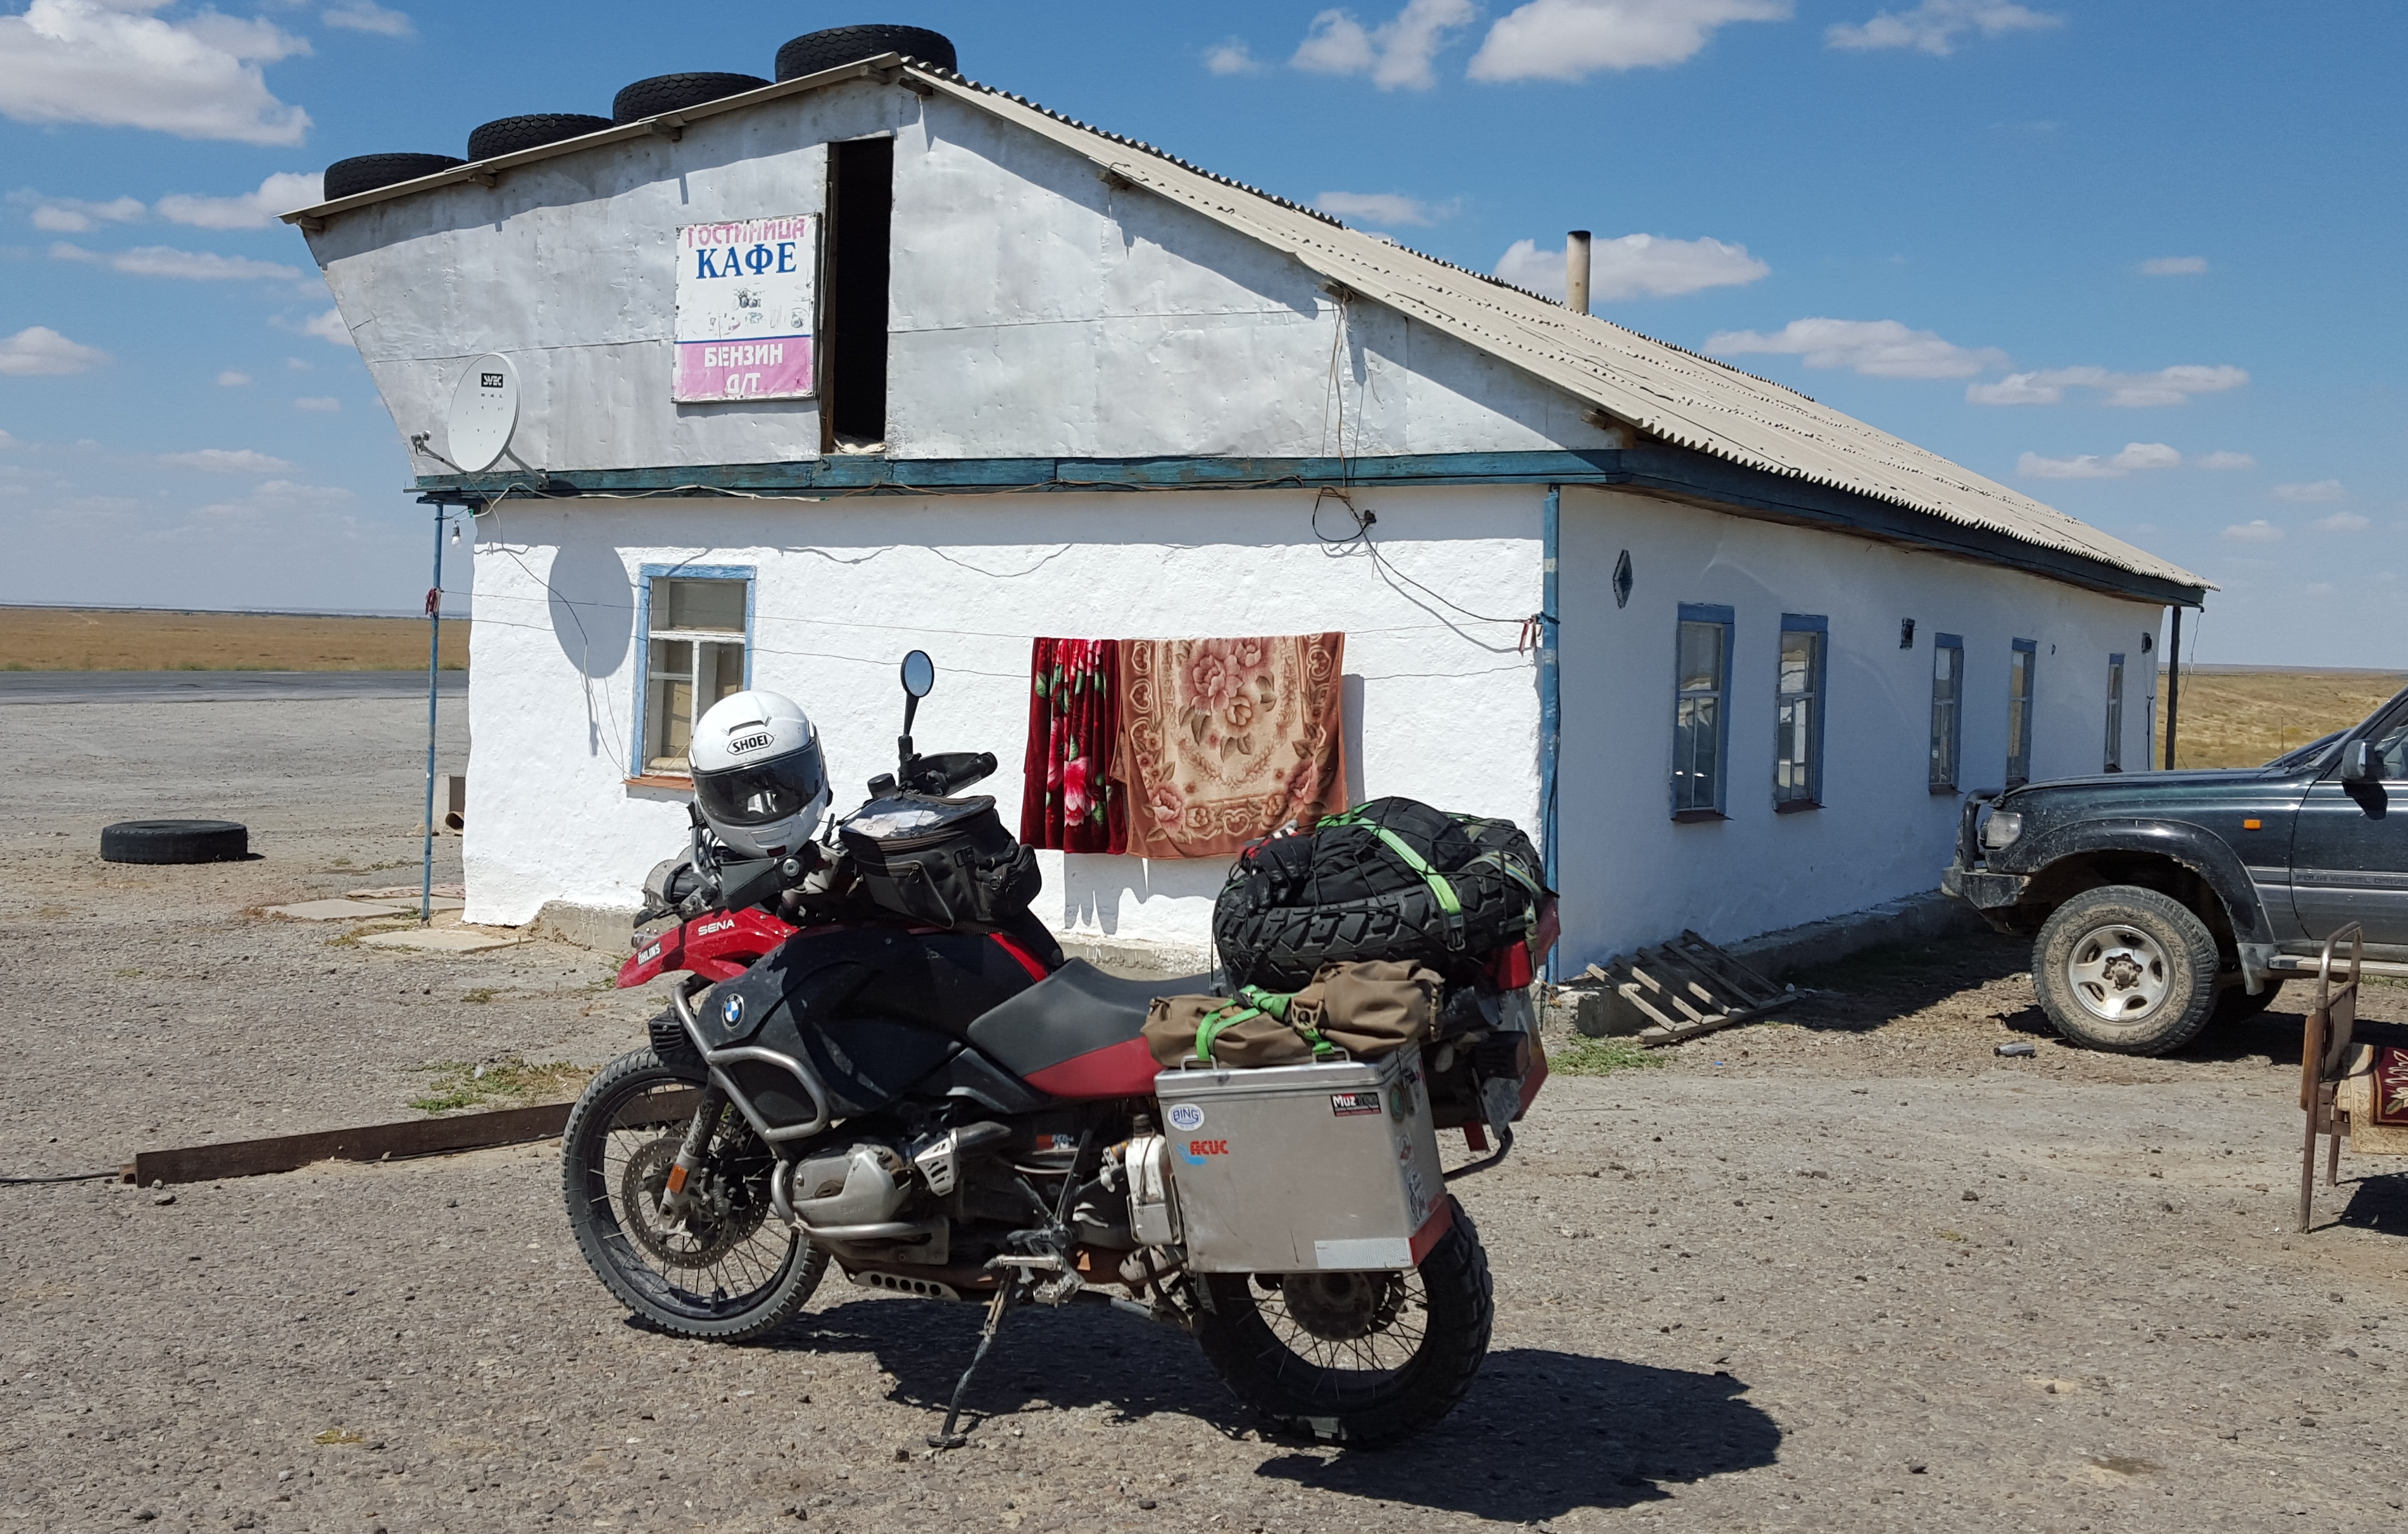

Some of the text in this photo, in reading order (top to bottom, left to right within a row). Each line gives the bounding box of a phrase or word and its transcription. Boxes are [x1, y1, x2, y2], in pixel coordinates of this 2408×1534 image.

[687, 218, 806, 249] ГОСТИНИЦА
[696, 242, 797, 279] КАФЕ
[704, 343, 784, 369] БЕНЗИН
[726, 373, 761, 394] Д/Т
[732, 734, 768, 753] SHOEI
[2330, 876, 2371, 884] WHEEL
[698, 919, 735, 936] SENA
[1173, 1108, 1199, 1121] BING
[1190, 1140, 1229, 1155] ACUC
